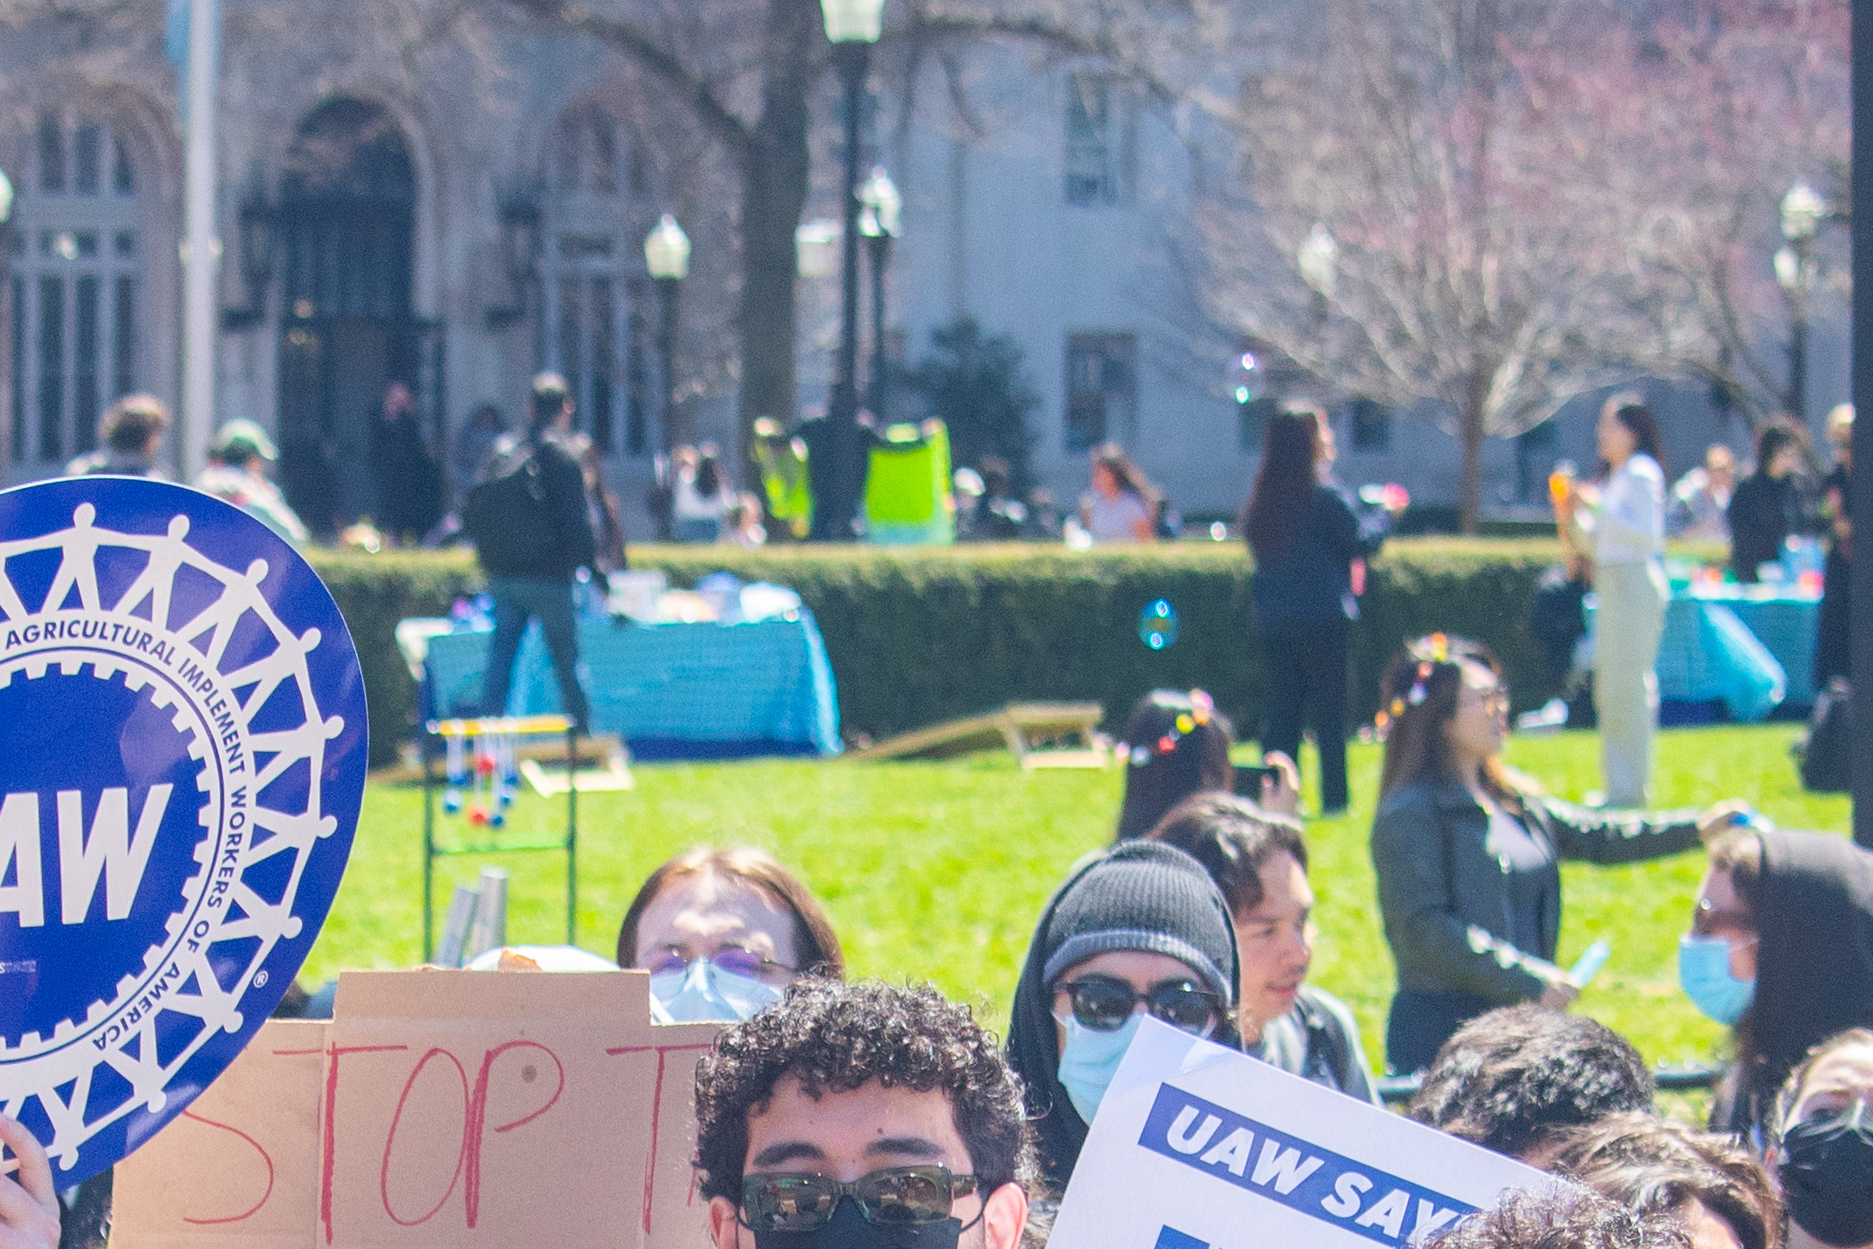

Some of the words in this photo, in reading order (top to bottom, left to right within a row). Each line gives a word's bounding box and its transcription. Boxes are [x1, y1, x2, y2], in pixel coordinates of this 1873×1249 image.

[5, 619, 177, 666] AGRICULTURAL
[176, 656, 246, 774] IMPLEMENT
[207, 784, 247, 909] WORKERS
[186, 919, 210, 954] OF
[91, 960, 181, 1052] AMERICA
[1165, 1104, 1325, 1196] UAW
[1320, 1170, 1466, 1248] SAY
